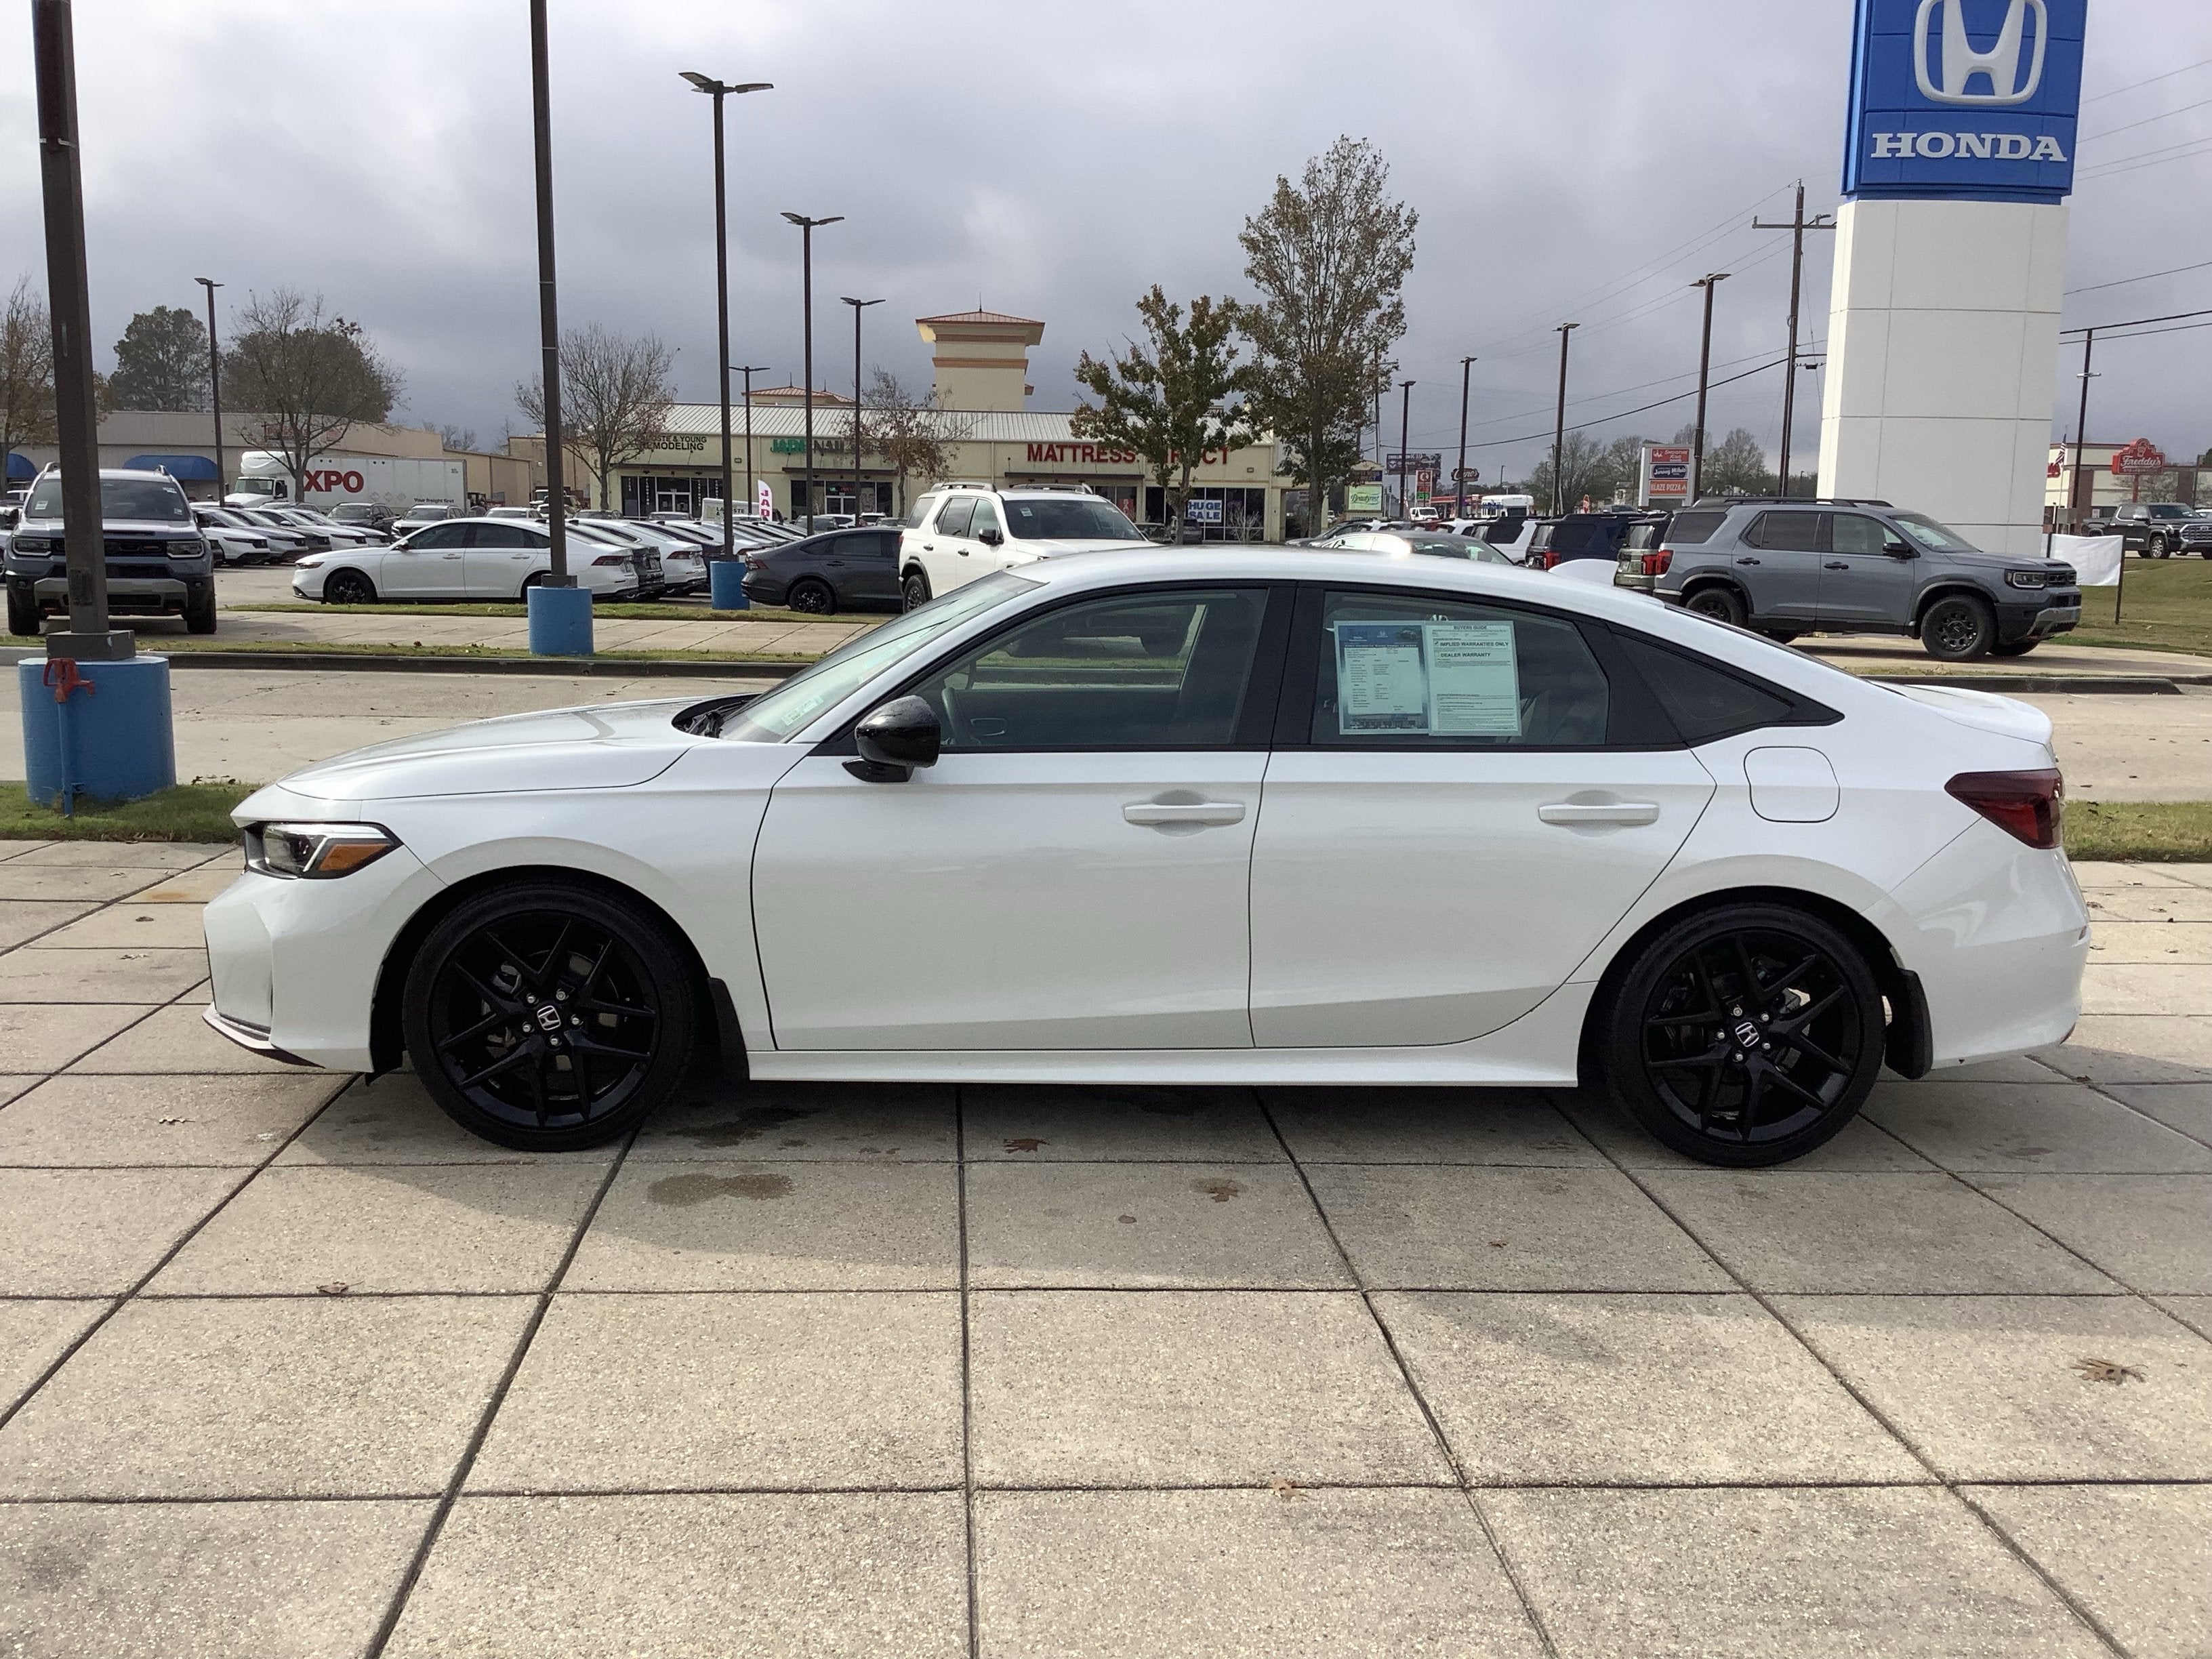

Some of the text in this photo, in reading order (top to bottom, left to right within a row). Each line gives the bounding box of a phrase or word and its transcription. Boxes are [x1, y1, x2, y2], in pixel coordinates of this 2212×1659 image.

[1871, 132, 2067, 162] HONDA
[1027, 444, 1136, 464] MATTRESS
[2121, 455, 2161, 467] Freddy's
[304, 470, 365, 493] XPO
[1189, 501, 1221, 510] HUGE
[1189, 511, 1221, 520] SALE
